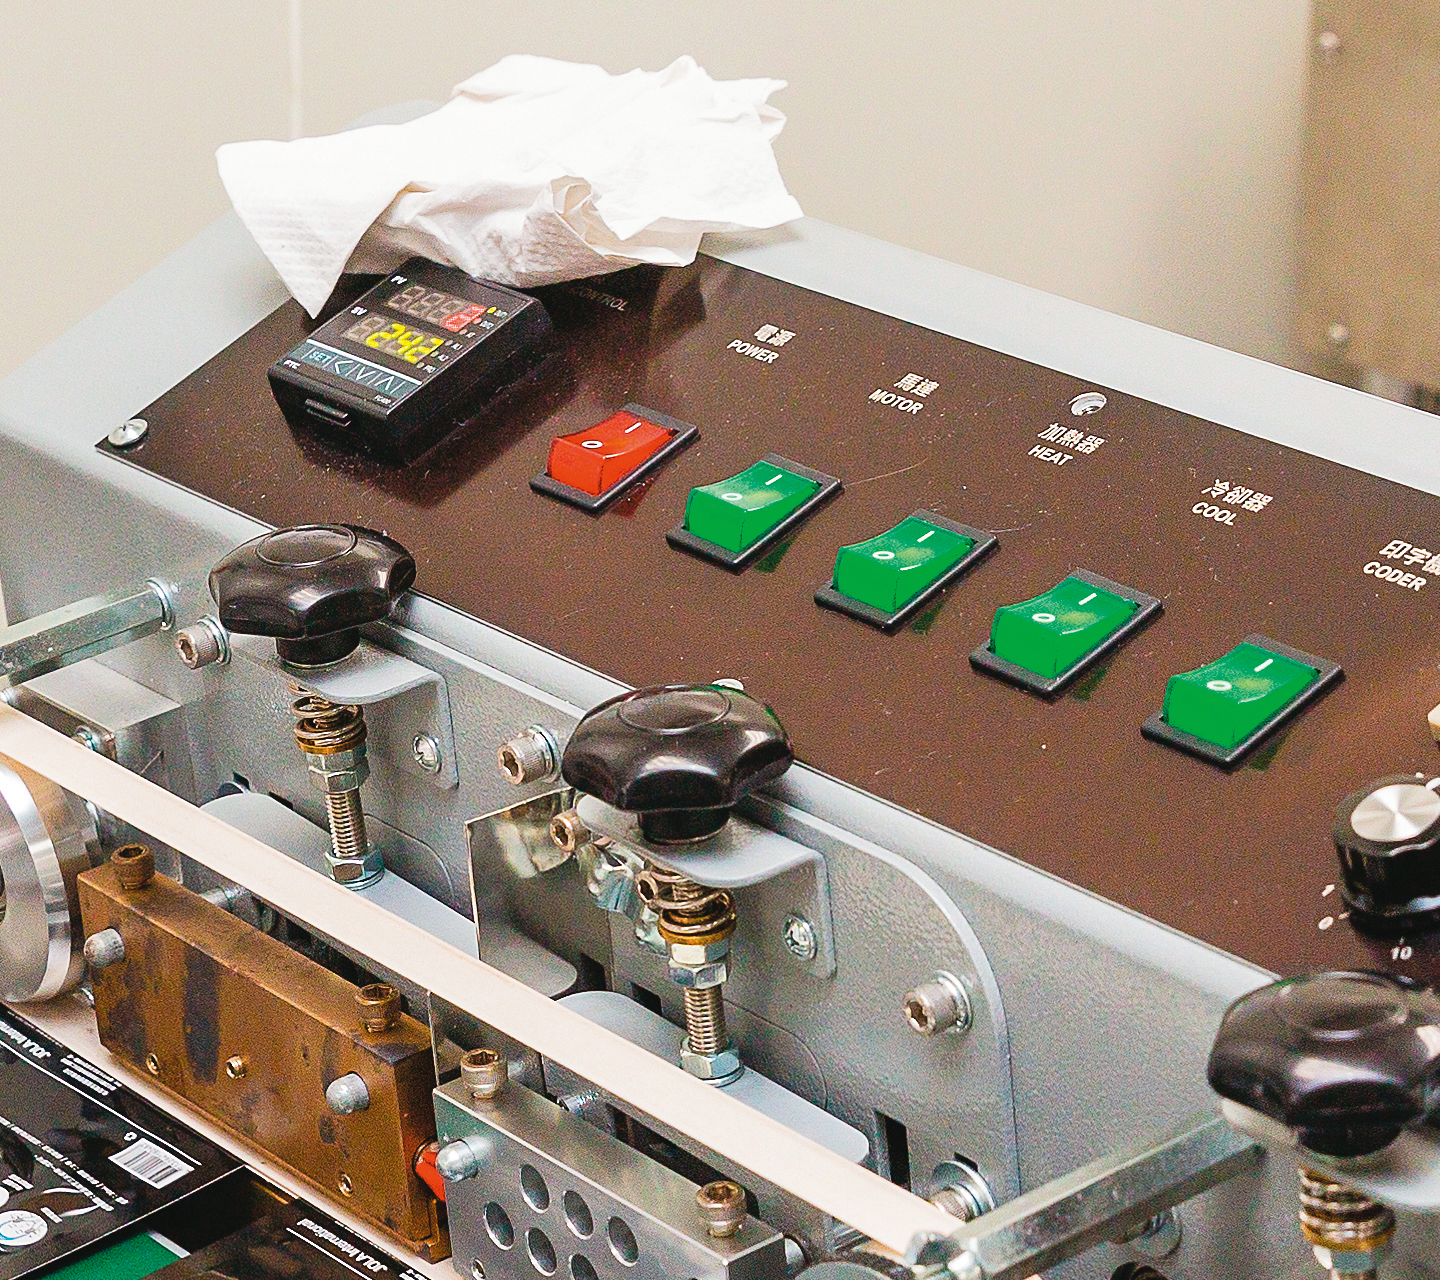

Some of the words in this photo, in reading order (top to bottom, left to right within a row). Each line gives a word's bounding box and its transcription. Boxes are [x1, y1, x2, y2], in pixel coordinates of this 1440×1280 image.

[753, 322, 798, 348] 電源
[309, 348, 332, 364] SET
[726, 339, 780, 365] POWER
[892, 371, 941, 399] 馬達
[868, 387, 925, 415] MOTOR
[1037, 421, 1106, 457] 加熱器
[1027, 443, 1074, 467] HEAT
[1201, 478, 1274, 515] 冷卻器
[1191, 499, 1239, 527] COOL
[1362, 560, 1428, 592] CODER
[1390, 945, 1413, 961] 10
[21, 1039, 52, 1059] JOLA
[296, 1217, 361, 1258] International
[355, 1251, 388, 1273] JOLA
